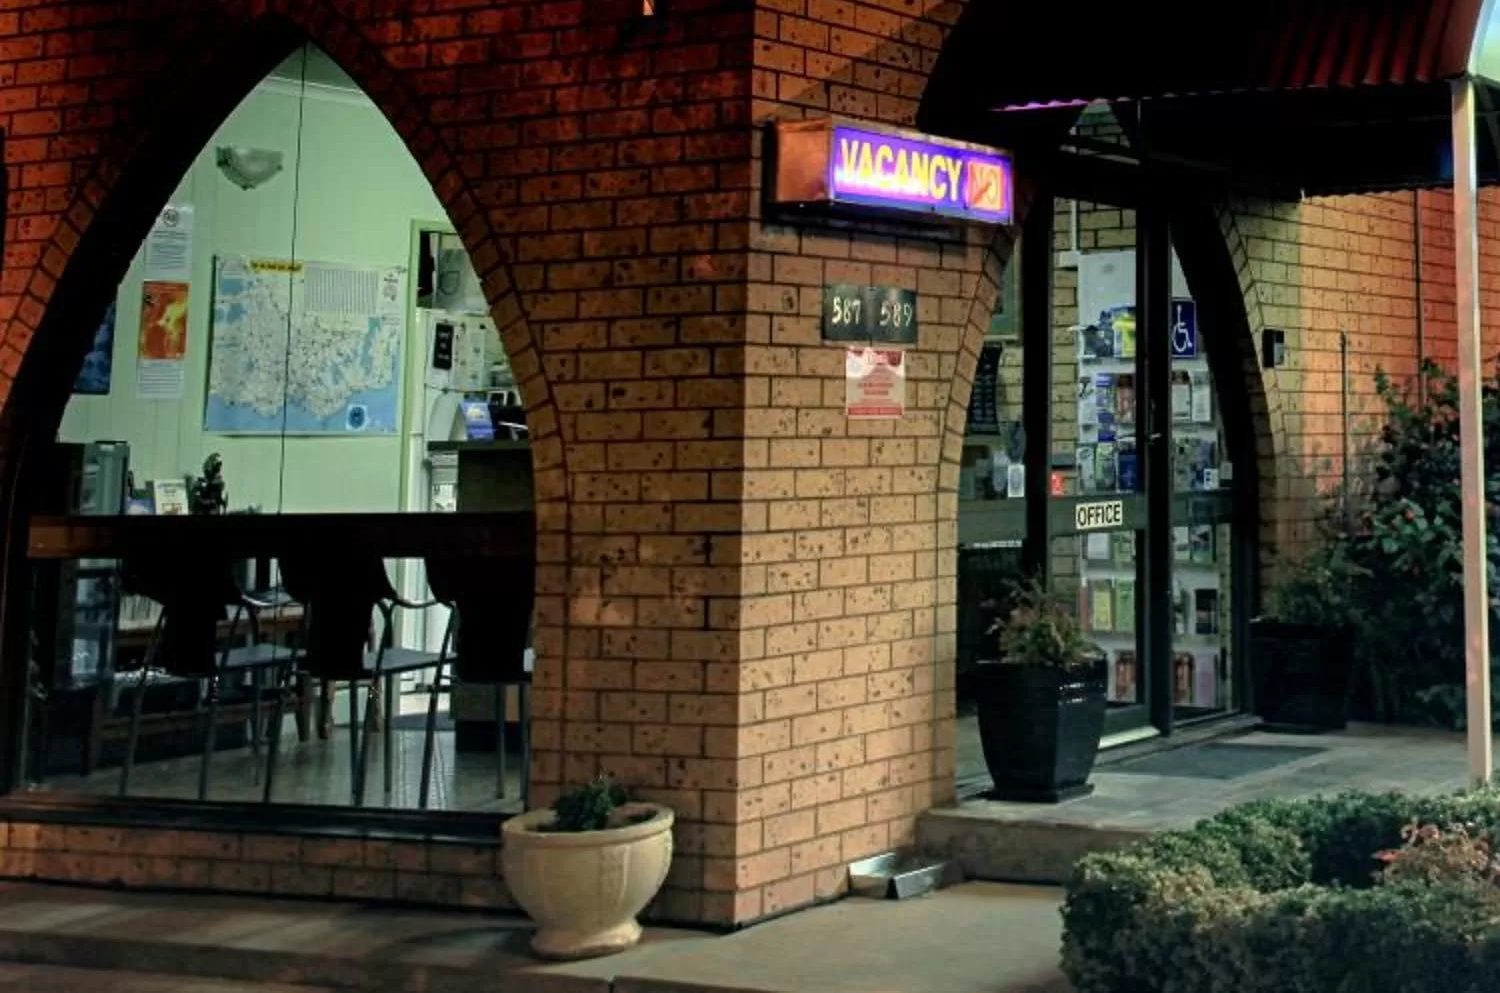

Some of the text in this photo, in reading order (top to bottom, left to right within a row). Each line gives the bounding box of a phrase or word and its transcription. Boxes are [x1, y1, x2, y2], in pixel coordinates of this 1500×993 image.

[840, 137, 962, 202] VACANCY
[831, 296, 913, 327] 587 589
[1077, 504, 1121, 526] OFFICE
